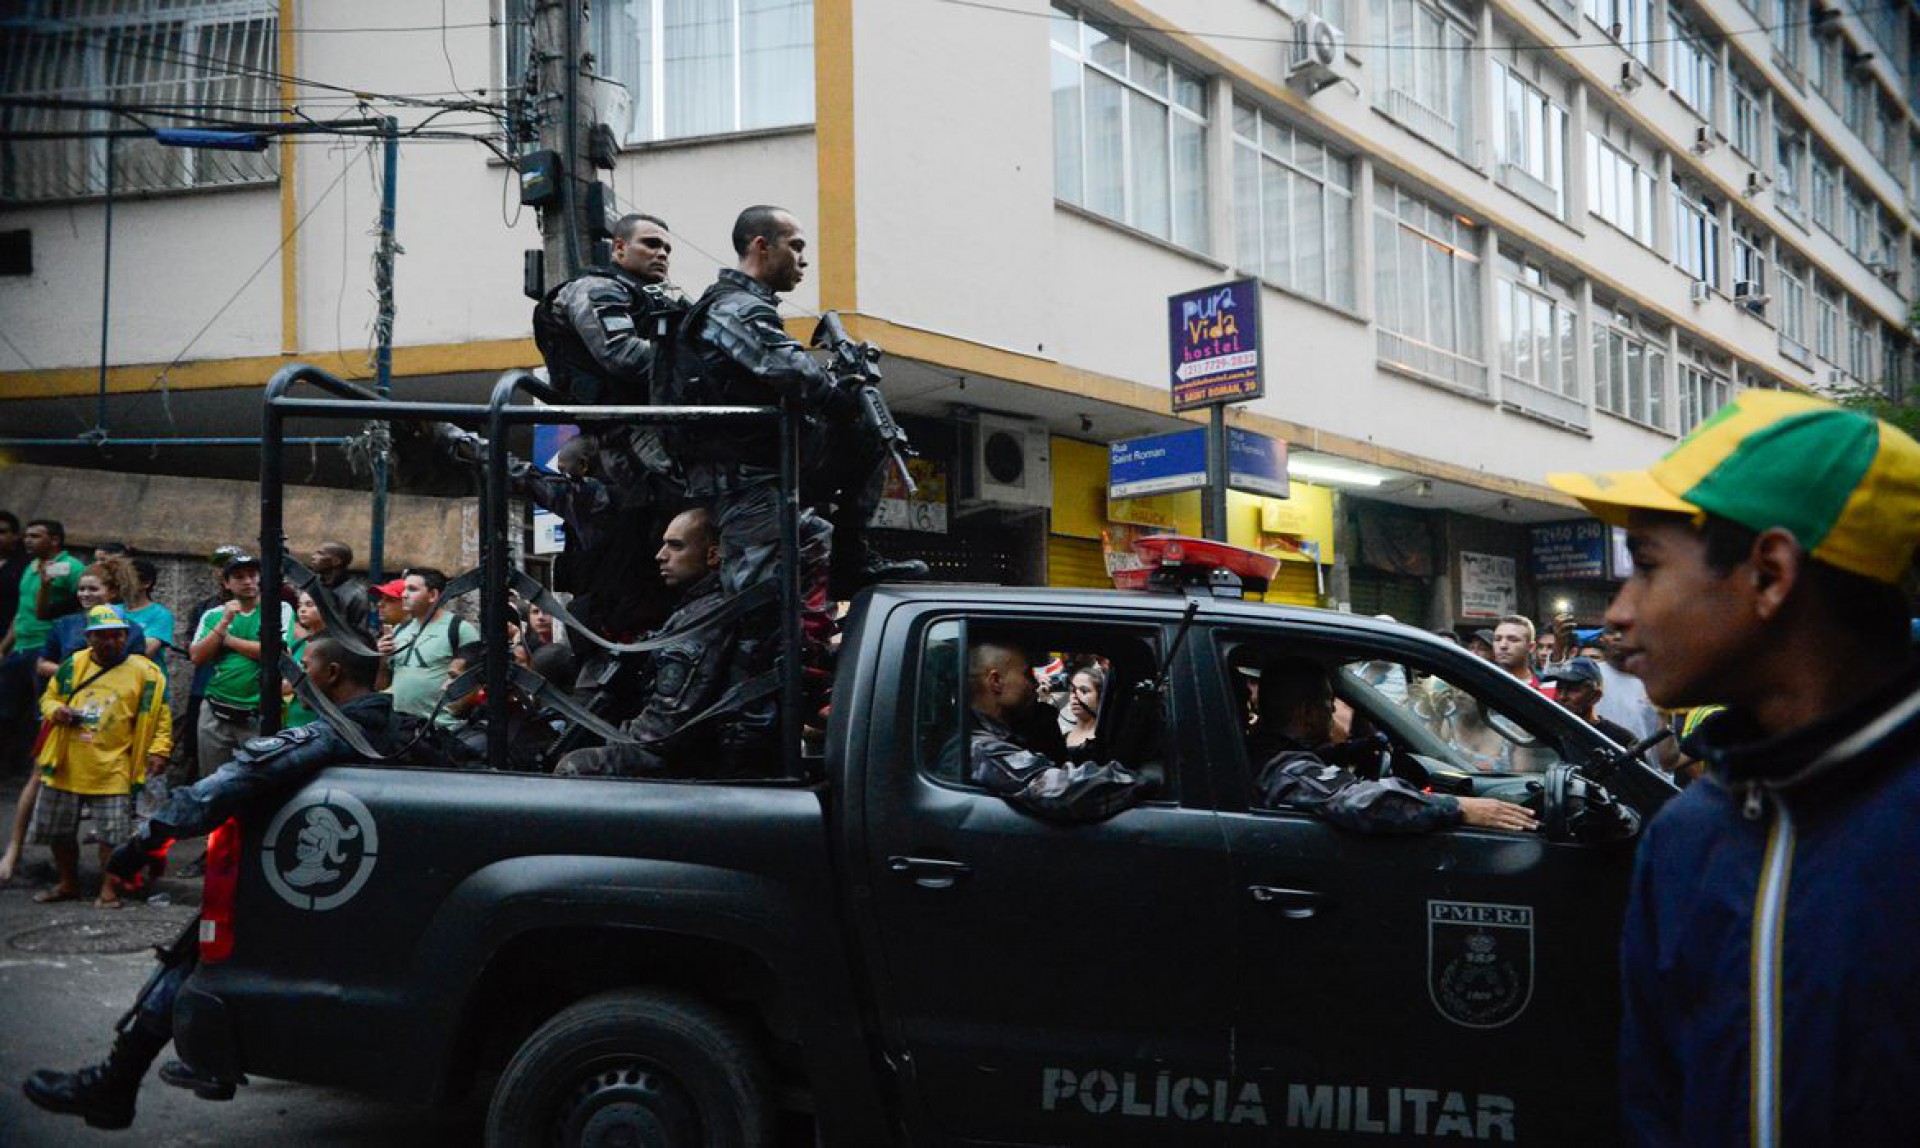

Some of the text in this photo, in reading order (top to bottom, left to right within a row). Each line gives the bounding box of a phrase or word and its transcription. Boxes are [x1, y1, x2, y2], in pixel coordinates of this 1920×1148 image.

[1183, 287, 1237, 331] pura
[1190, 310, 1239, 345] Vida
[1184, 334, 1240, 361] hostel
[1112, 443, 1128, 454] Rua
[1112, 448, 1166, 465] Saint Roman
[1042, 1067, 1515, 1142] POLÍCIA MILITAR
